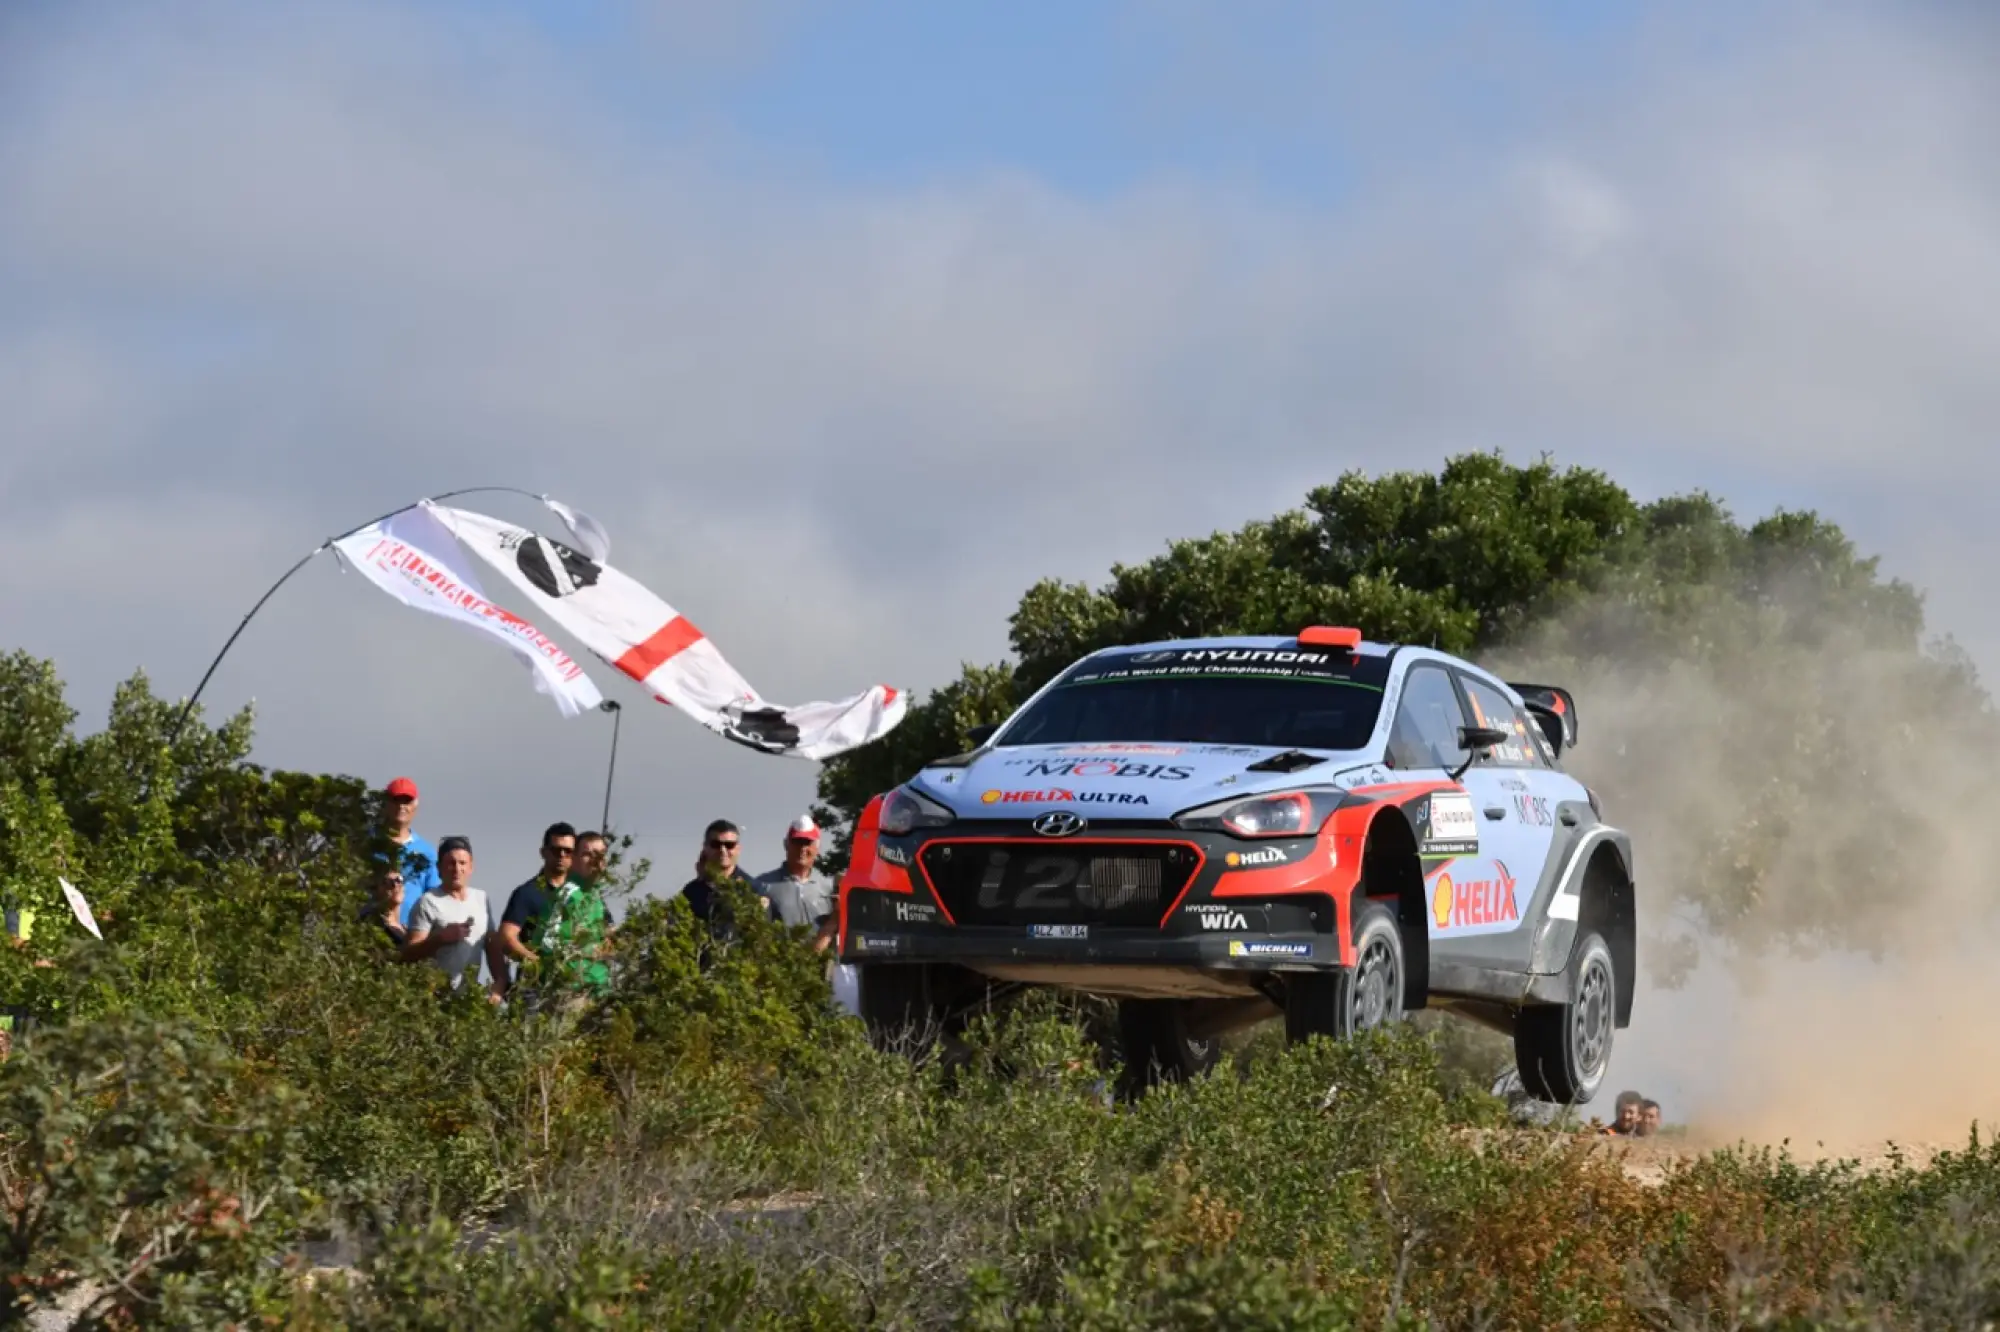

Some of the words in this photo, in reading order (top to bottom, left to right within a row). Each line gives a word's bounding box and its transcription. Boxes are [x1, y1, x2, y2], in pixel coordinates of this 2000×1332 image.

[1181, 650, 1329, 664] HYUNDAI
[1132, 666, 1168, 677] World
[1170, 665, 1202, 675] Rally
[1204, 664, 1293, 677] Championship
[1024, 761, 1196, 780] MOBIS
[1001, 788, 1075, 803] HELIX
[1074, 792, 1150, 805] ULTRA
[1239, 846, 1288, 865] HELIX
[1455, 866, 1519, 927] HELIX
[1248, 943, 1308, 954] MICHELIN
